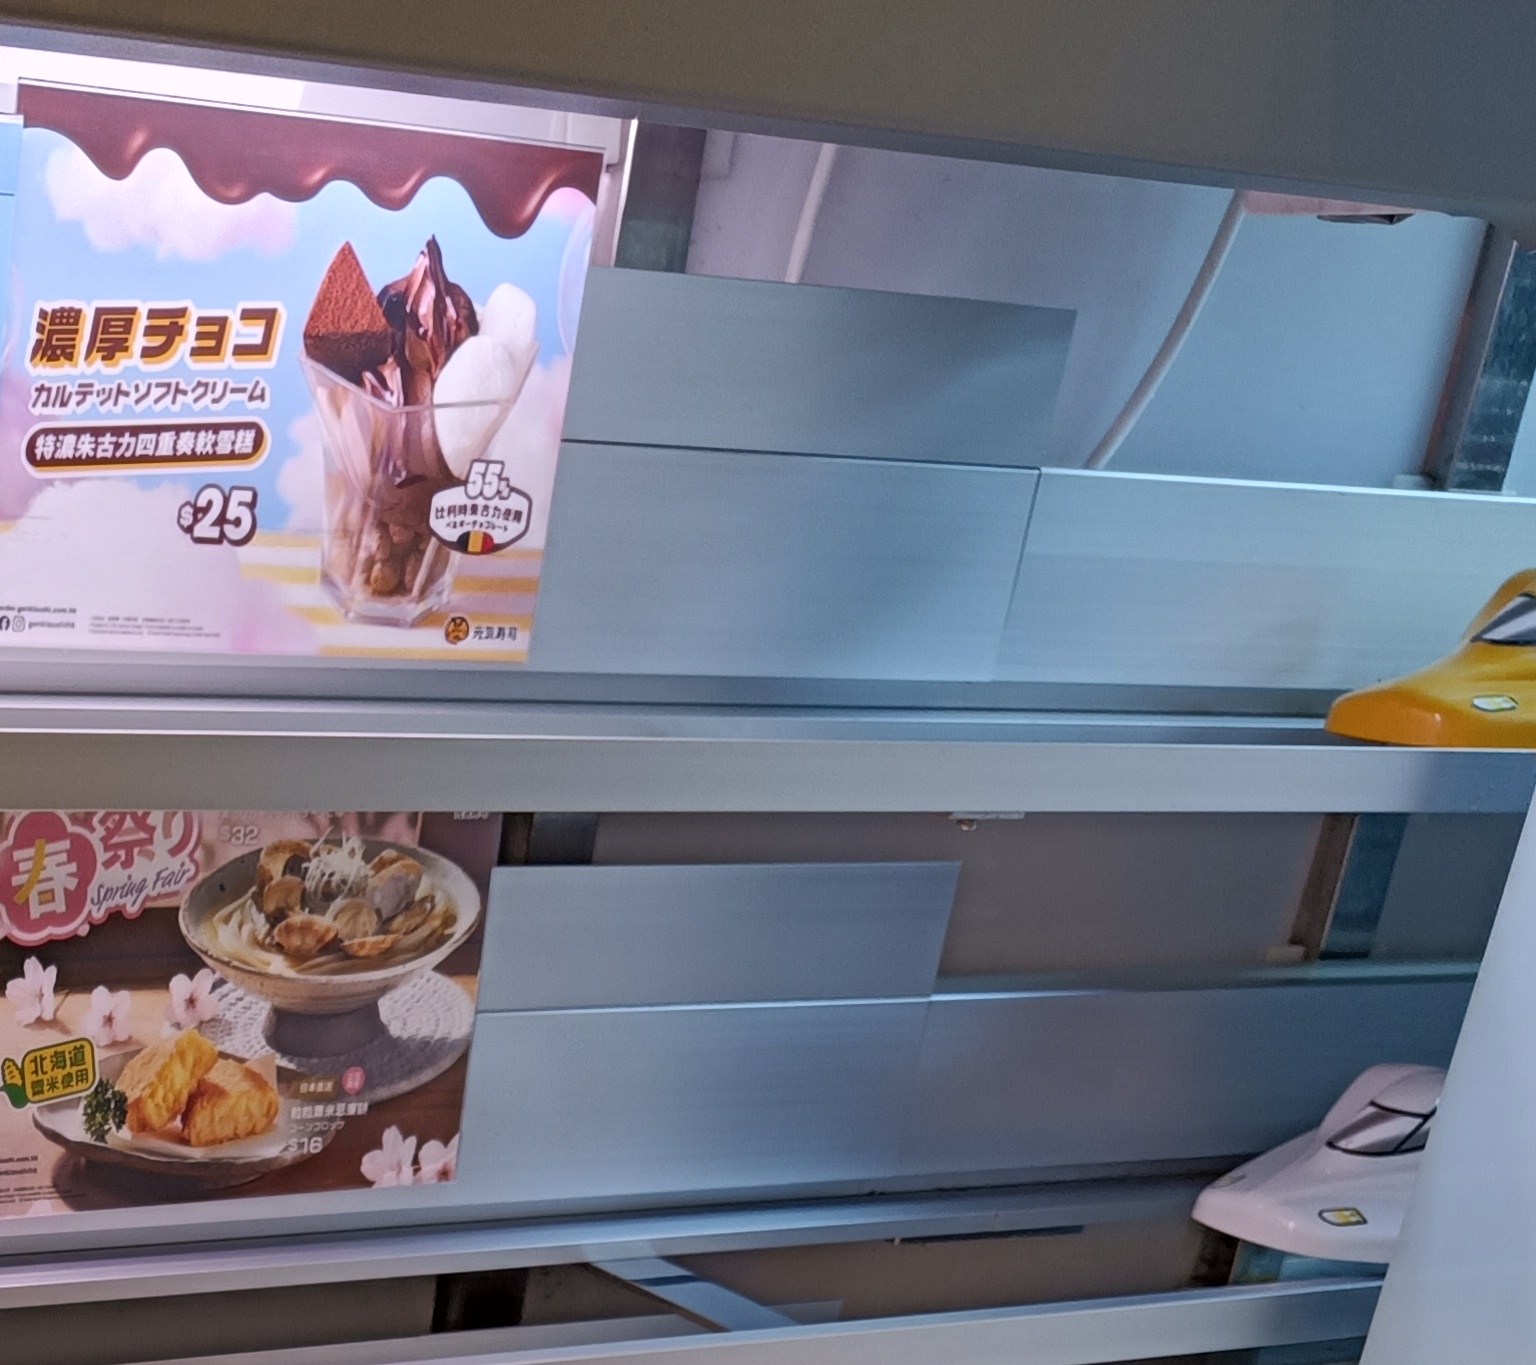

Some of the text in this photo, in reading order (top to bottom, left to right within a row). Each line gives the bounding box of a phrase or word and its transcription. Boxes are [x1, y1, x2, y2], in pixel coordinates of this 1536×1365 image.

[30, 306, 280, 365] 濃厚チョコ
[31, 380, 269, 412] カルテットソフトクリーム
[35, 426, 257, 461] 特濃朱古力四重奏軟雪糕
[179, 488, 257, 541] $25
[472, 626, 517, 641] 元気寿司
[13, 838, 79, 920] 春
[90, 864, 191, 908] Spring Fair
[29, 1045, 87, 1077] 北海道
[287, 1136, 324, 1155] $16
